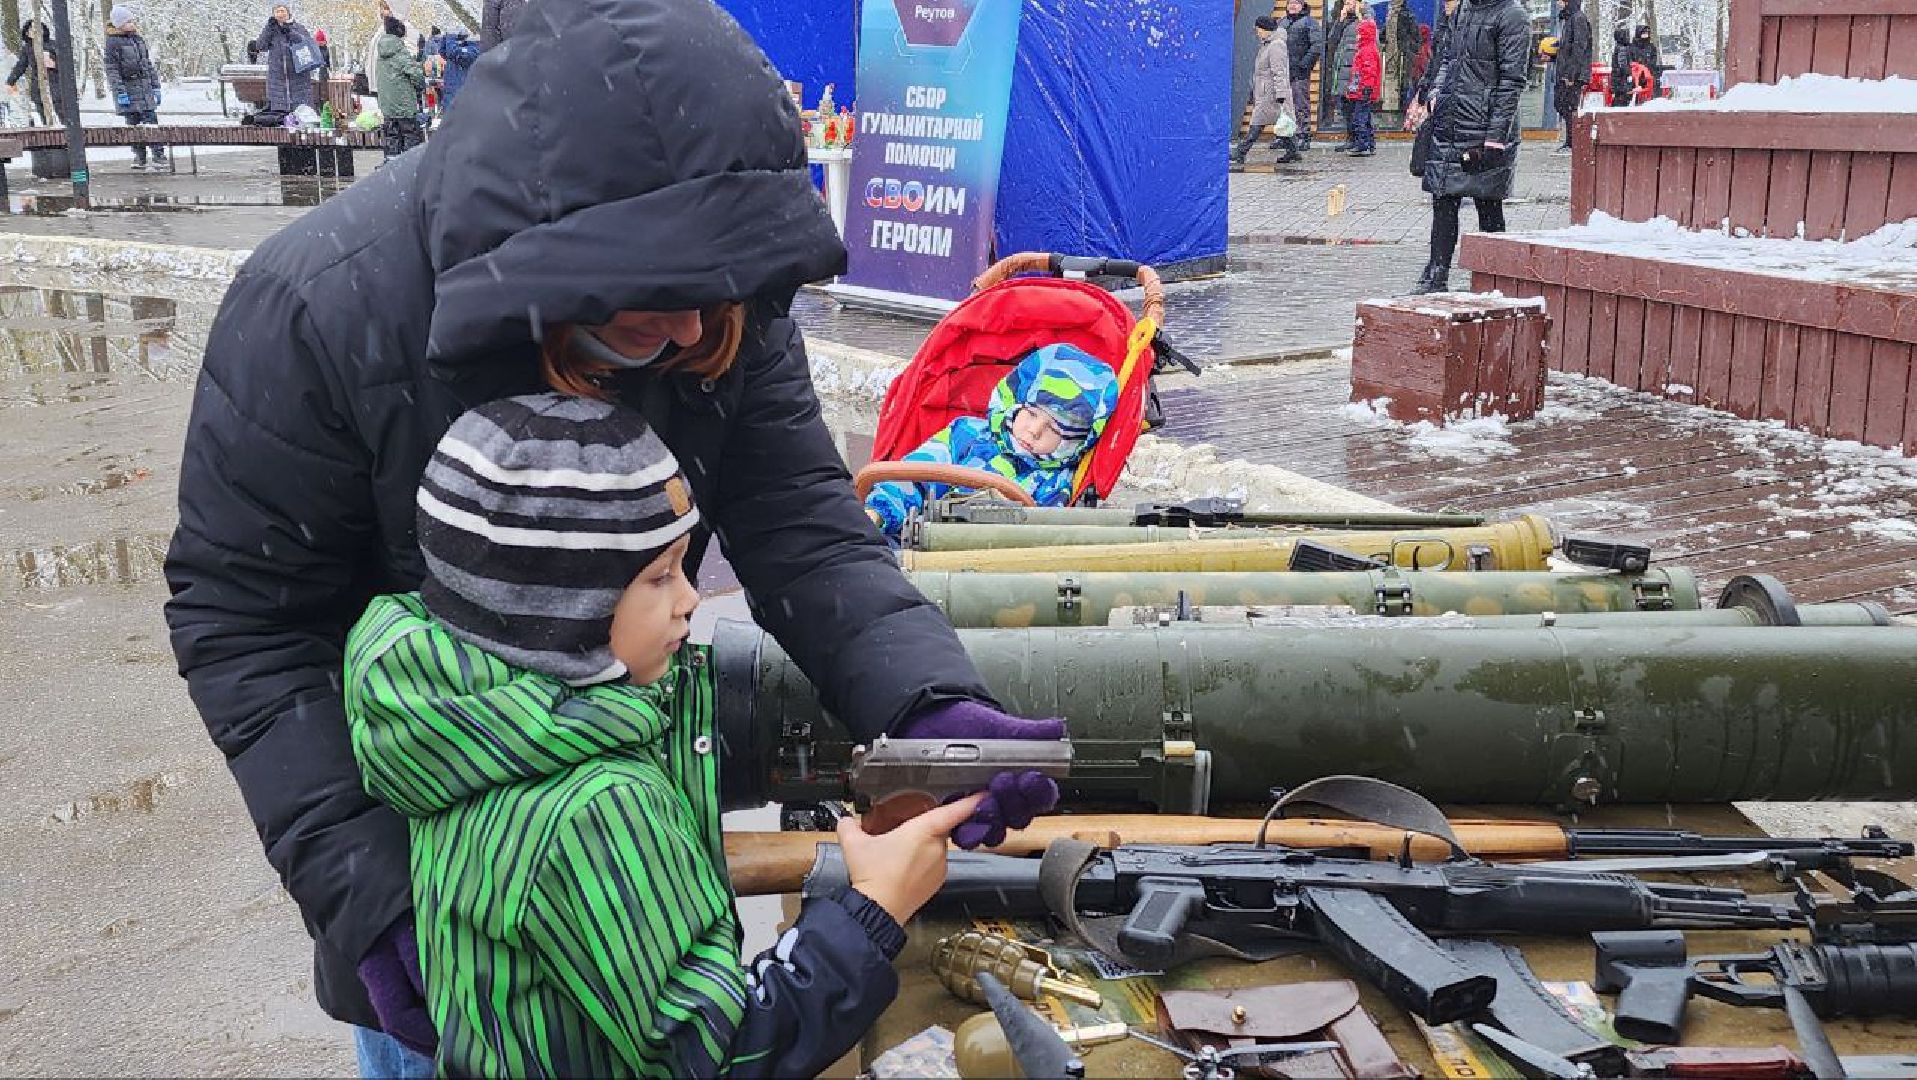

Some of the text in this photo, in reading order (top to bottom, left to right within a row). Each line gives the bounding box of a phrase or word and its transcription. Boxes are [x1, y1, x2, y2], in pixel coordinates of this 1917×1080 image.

[914, 5, 955, 22] Реутов
[906, 86, 946, 110] СБОР
[861, 112, 984, 141] ГУМАНИТАРНОЙ
[885, 142, 956, 172] ПОМОЩИ
[864, 177, 966, 216] СВОИМ
[870, 220, 953, 257] ГЕРОЯМ
